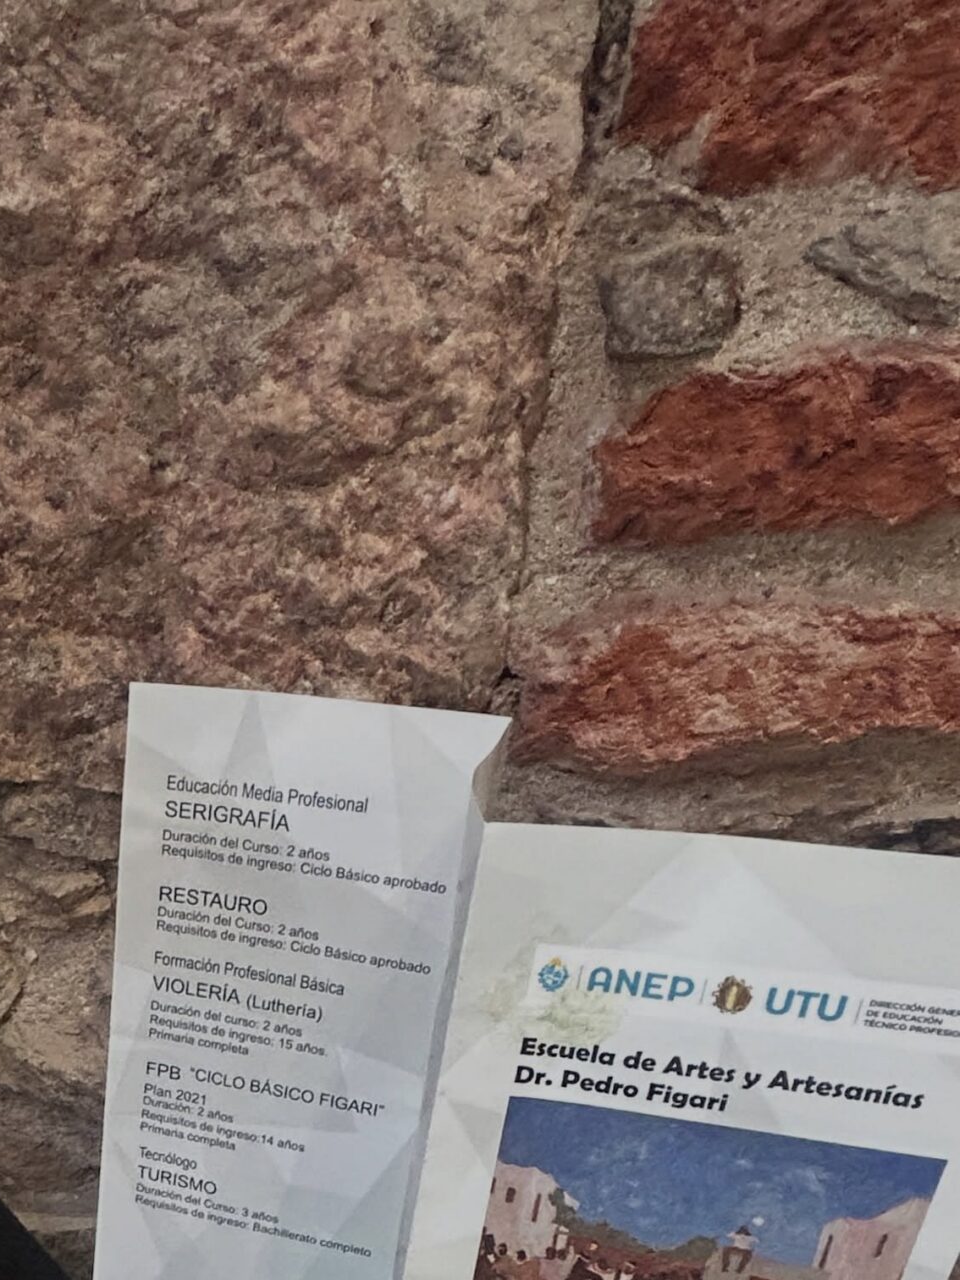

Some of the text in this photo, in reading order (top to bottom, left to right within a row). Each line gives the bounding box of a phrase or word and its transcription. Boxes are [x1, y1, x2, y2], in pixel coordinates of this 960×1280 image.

[167, 775, 368, 813] Educación Media Profesional
[165, 800, 289, 832] SERIGRAFÍA
[162, 829, 330, 861] Duración del Curso: 2 años
[162, 845, 447, 894] Requisitos de ingreso: Ciclo Básico aprobado
[159, 886, 267, 915] RESTAURO
[157, 906, 319, 941] Duración del Curso: 2 años
[156, 921, 431, 975] Requisitos de ingreso: Ciclo Básico aprobado
[153, 975, 240, 1004] VIOLERÍA
[154, 951, 344, 996] Formación Profesional Básica
[587, 966, 849, 1022] ANEP UTU
[869, 999, 926, 1013] DIRECCIÓN
[149, 1014, 208, 1035] Requisitos
[211, 1026, 226, 1037] de
[279, 1038, 293, 1050] 15
[150, 1000, 201, 1017] Duración
[204, 1009, 222, 1022] del
[262, 1020, 271, 1031] 2
[273, 1024, 302, 1037] años
[863, 1018, 907, 1031] TÉCNICO
[866, 1010, 943, 1025] DE EDUCACIÓN
[148, 1028, 249, 1055] Primaria completa
[146, 1061, 181, 1080] FPB
[250, 1079, 314, 1103] BÁSICO
[514, 1065, 728, 1111] Dr. Pedro Figari
[520, 1037, 924, 1109] Escuela de Artes y Artesanías
[144, 1083, 206, 1105] Plan 2021
[197, 1106, 205, 1117] 2
[207, 1110, 233, 1123] años
[139, 1121, 235, 1151] Primaria completa
[141, 1109, 197, 1130] Requisitos
[200, 1121, 214, 1133] de
[277, 1140, 305, 1153] años
[139, 1146, 197, 1170] Tecnólogo
[138, 1165, 217, 1194] TURISMO
